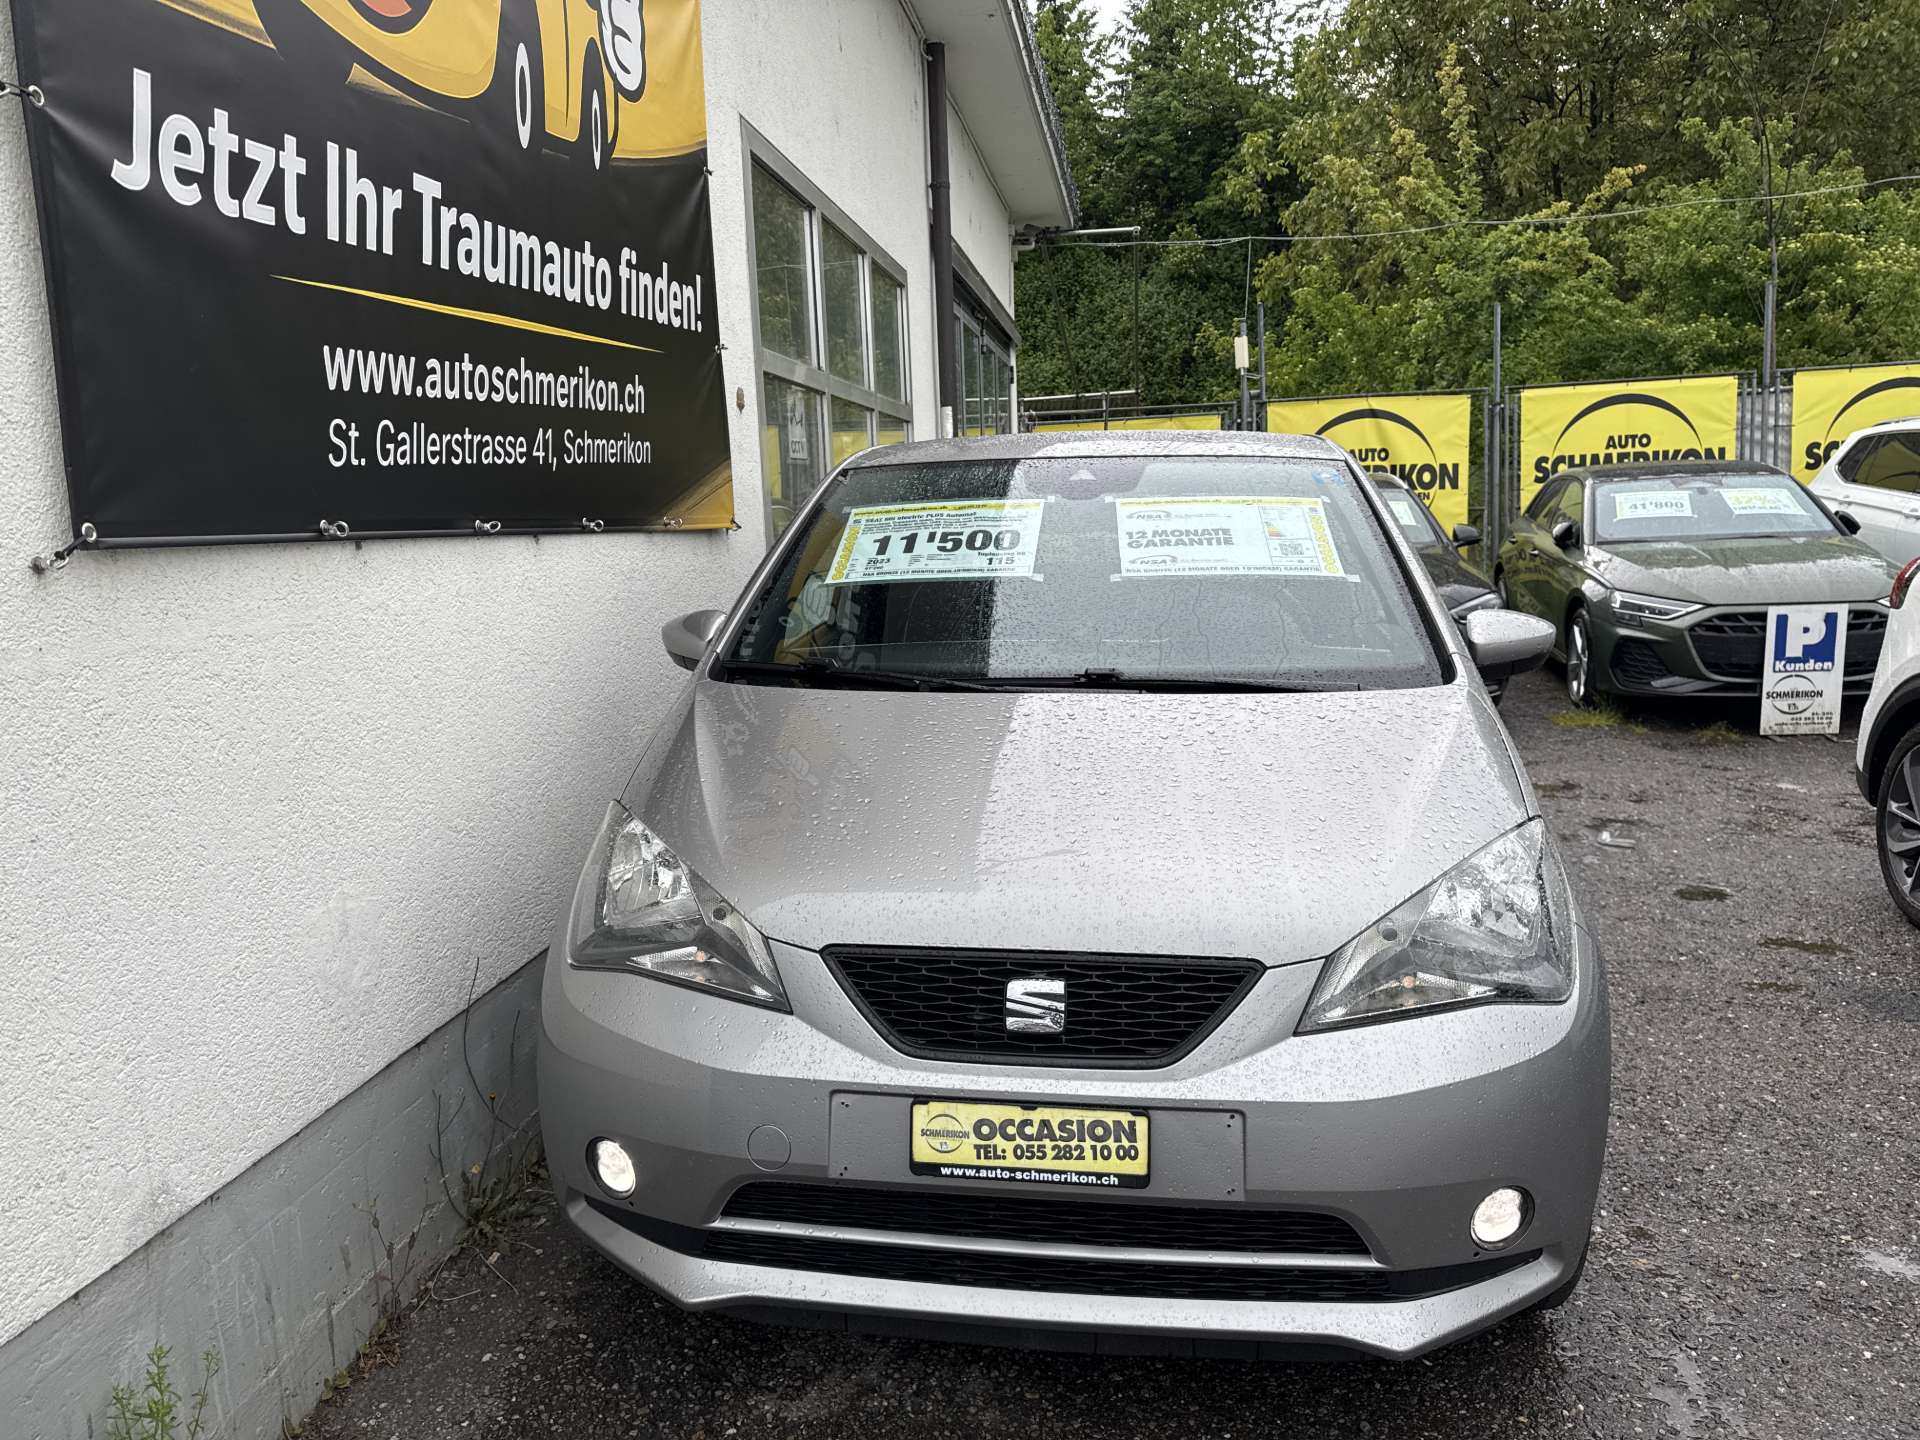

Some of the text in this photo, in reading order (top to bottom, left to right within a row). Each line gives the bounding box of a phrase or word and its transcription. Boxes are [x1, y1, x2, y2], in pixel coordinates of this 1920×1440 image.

[110, 67, 703, 334] Jetzt Ihr Traumauto finden!
[323, 344, 645, 415] www.autoschmerikon.ch
[328, 418, 651, 472] St. Gallerstrasse 41, Schmerikon
[1605, 433, 1652, 450] AUTO
[1349, 447, 1390, 462] AUTO
[1628, 501, 1684, 510] 41'800
[897, 513, 925, 521] electric
[1126, 528, 1232, 540] 12 MONATE
[872, 529, 1021, 556] 11'500
[1127, 537, 1235, 550] GARANTIE
[866, 557, 891, 566] 2023
[986, 557, 1015, 566] 115
[1785, 611, 1827, 658] P
[1774, 659, 1833, 672] Kunden
[1765, 689, 1824, 700] SCHMERIKON
[920, 1128, 970, 1140] SCHMERIKON
[972, 1117, 1138, 1144] OCCASION
[973, 1144, 1139, 1161] TEL: 055 282 10 00
[940, 1165, 1119, 1186] www.auto-schmerikon.ch
